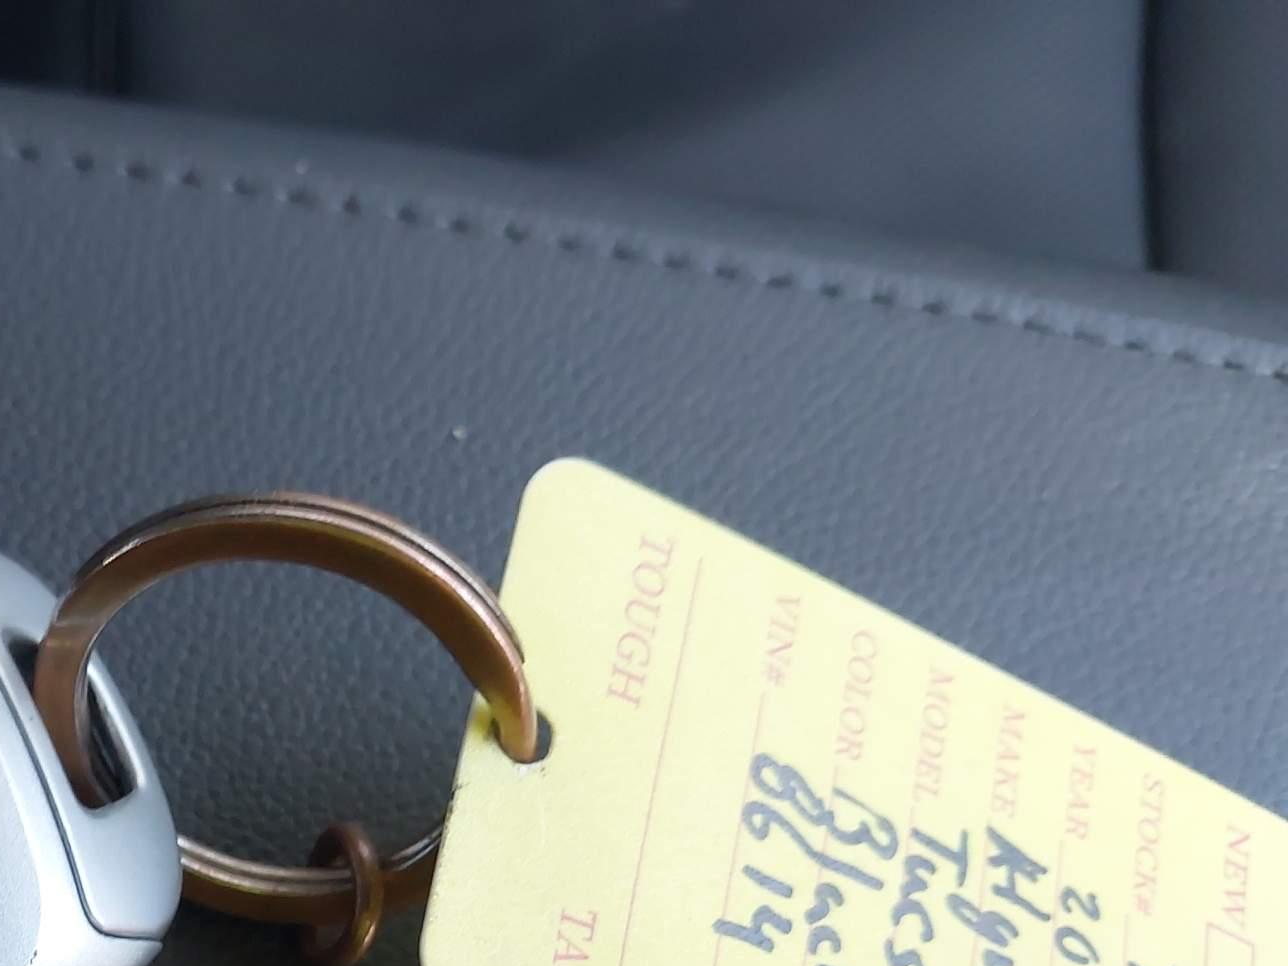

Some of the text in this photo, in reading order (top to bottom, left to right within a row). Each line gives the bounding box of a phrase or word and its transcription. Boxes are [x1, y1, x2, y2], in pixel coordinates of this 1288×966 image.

[606, 534, 675, 708] TOUGH
[764, 593, 802, 688] VIN#
[834, 629, 879, 762] COLOR
[911, 666, 956, 804] MODEL
[990, 704, 1028, 815] MAKE
[712, 752, 825, 954] 8614
[1063, 742, 1098, 842] YEAR
[1131, 772, 1166, 918] STOCK#
[1221, 825, 1253, 929] NEW
